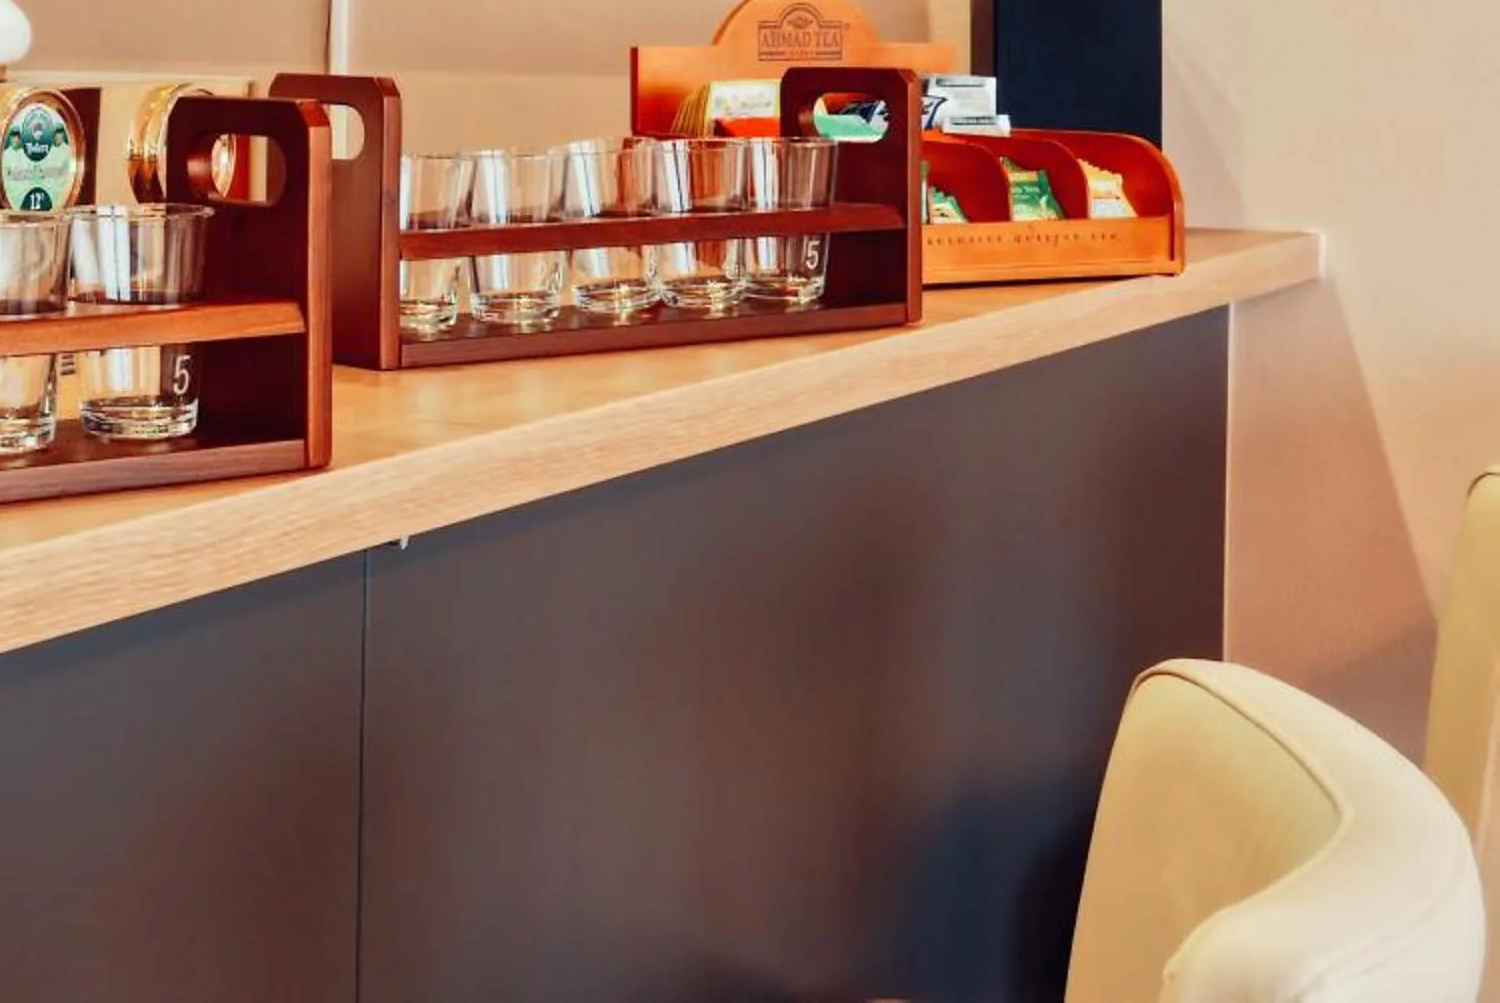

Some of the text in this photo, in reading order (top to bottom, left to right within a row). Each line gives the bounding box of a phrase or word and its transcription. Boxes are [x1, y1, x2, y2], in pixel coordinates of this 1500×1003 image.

[761, 31, 840, 48] AHMAD TEA
[805, 239, 821, 270] 5
[173, 353, 192, 395] 5
